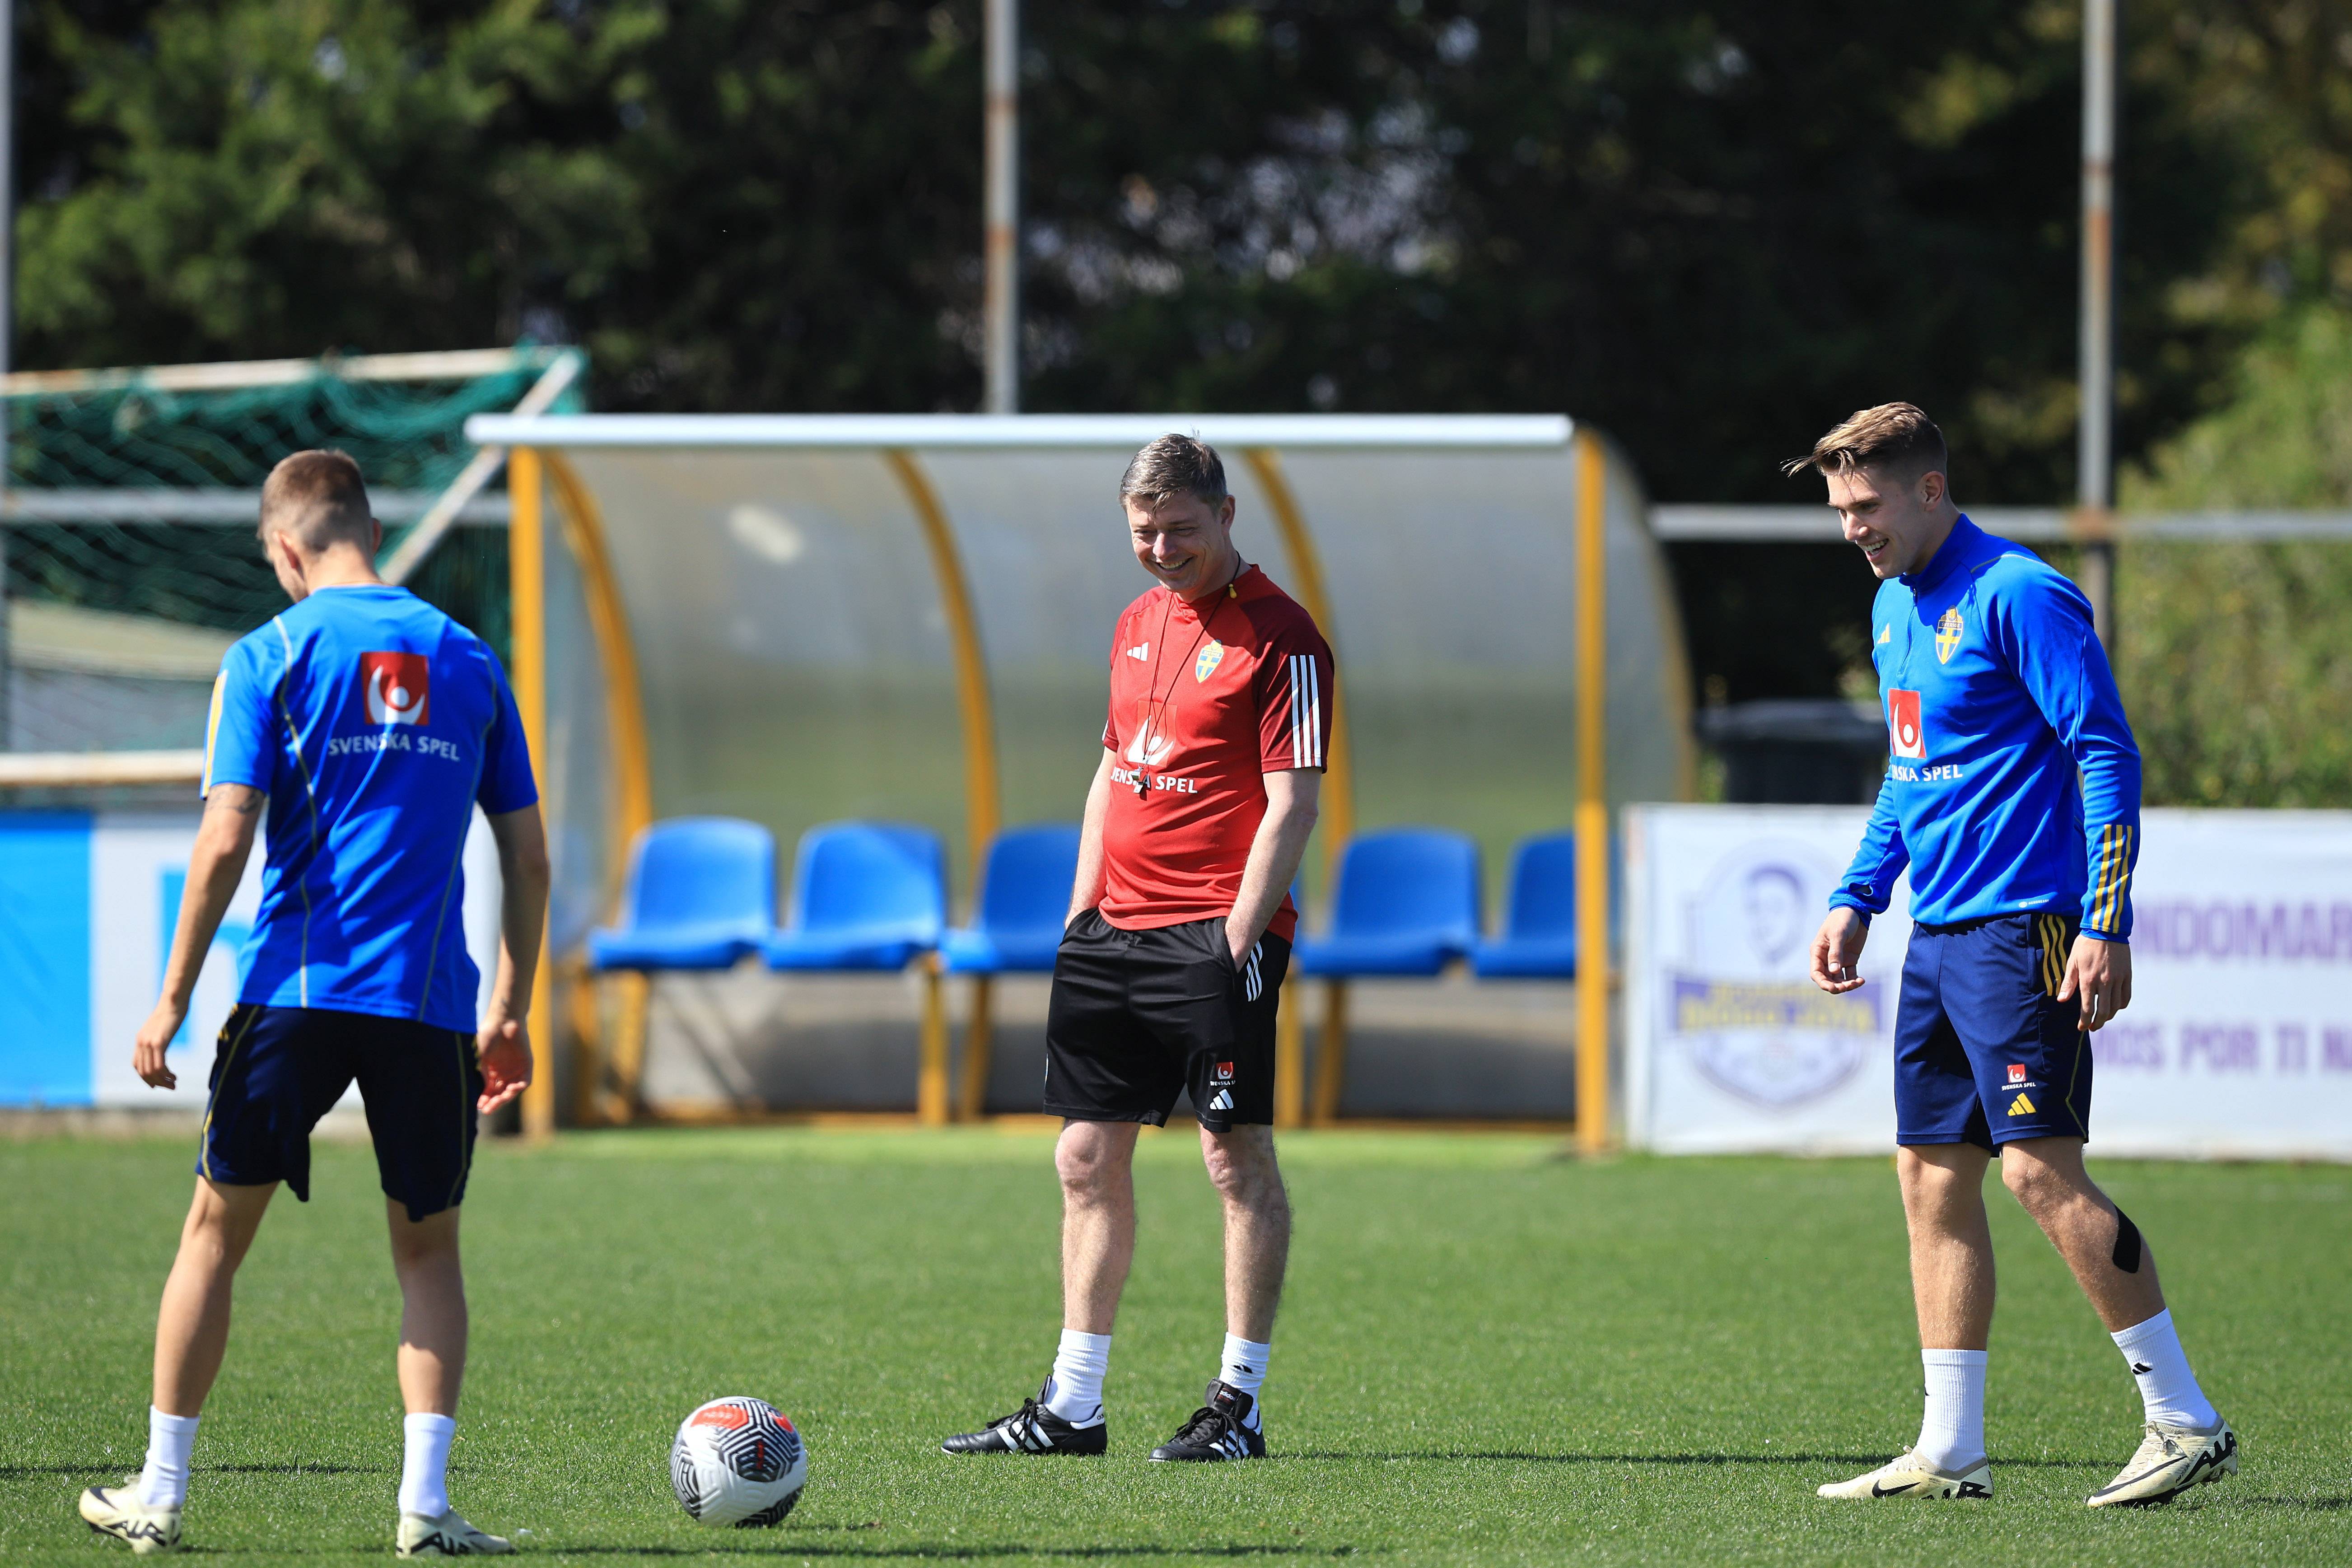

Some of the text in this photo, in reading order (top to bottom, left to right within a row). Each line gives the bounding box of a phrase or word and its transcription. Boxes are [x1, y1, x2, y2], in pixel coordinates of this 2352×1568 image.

[328, 732, 460, 762] SVENSKA SPEL
[1922, 764, 1963, 782] SPEL
[1155, 775, 1198, 793] SPEL
[2002, 1083, 2023, 1091] SVENSKA
